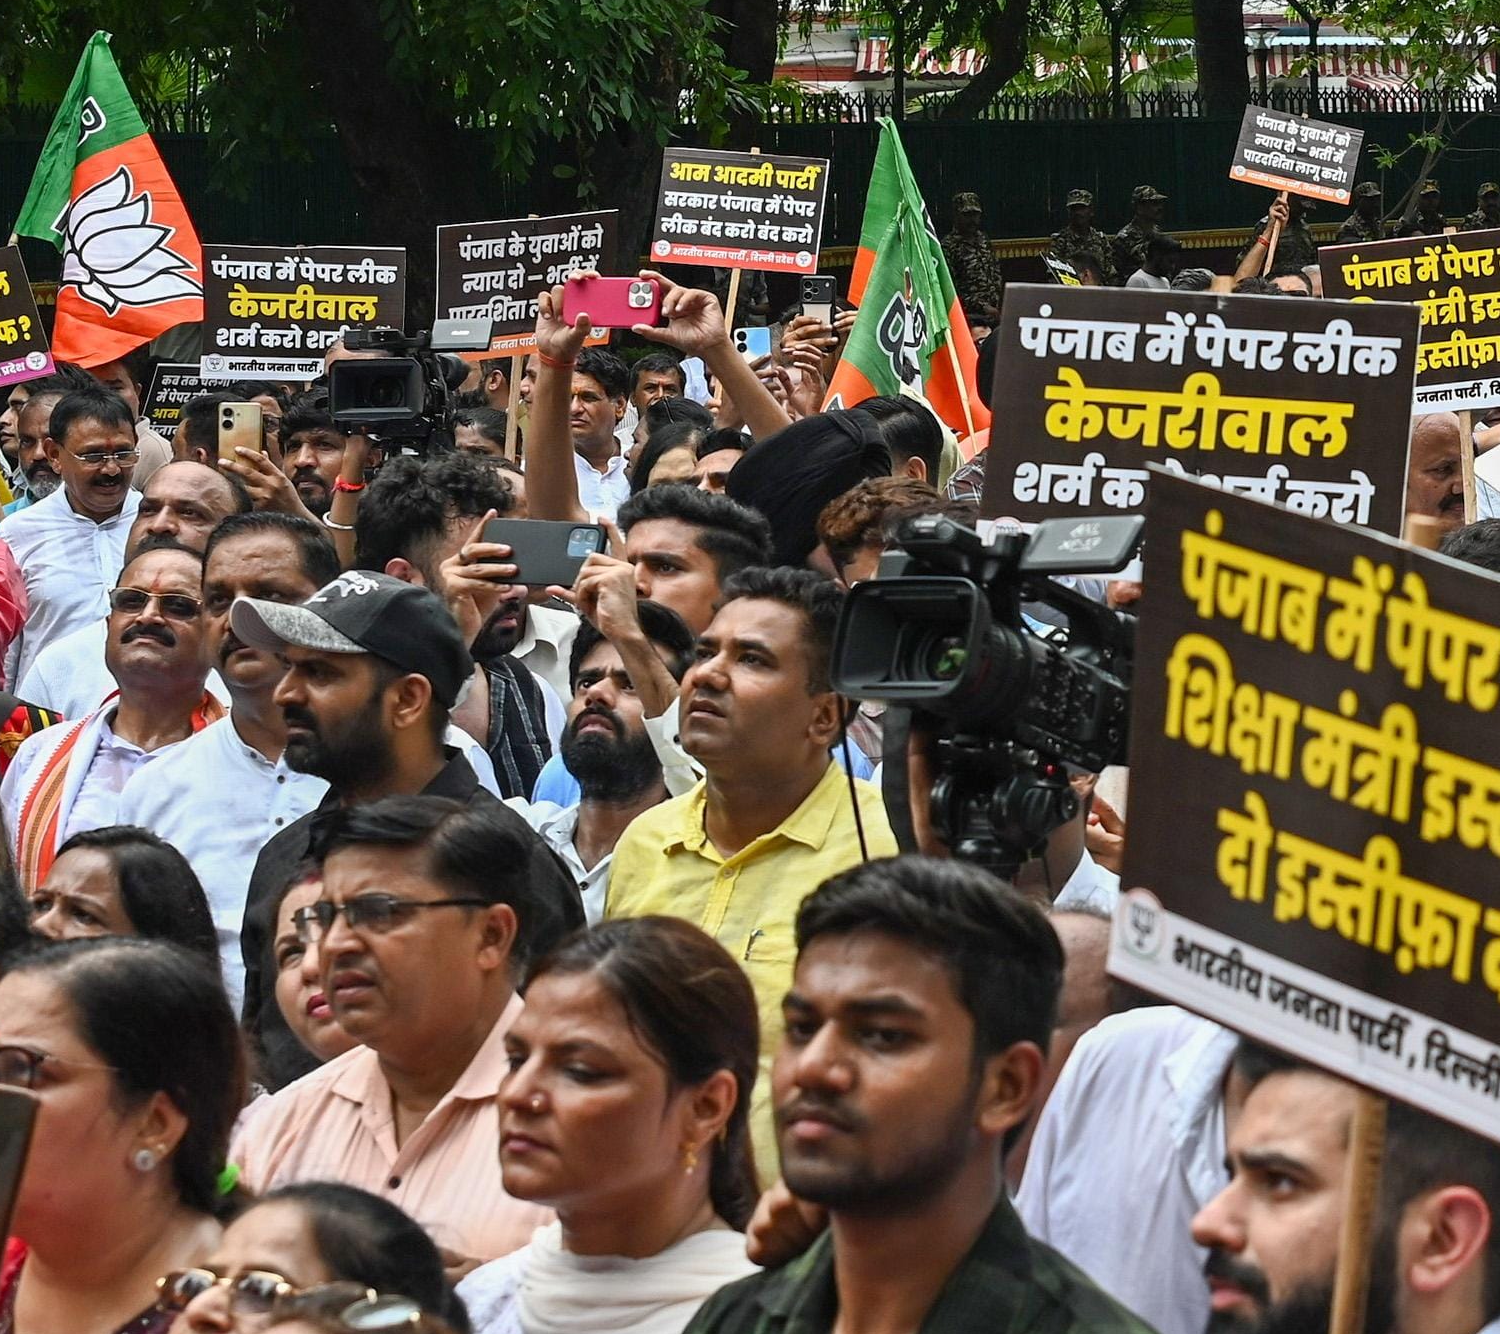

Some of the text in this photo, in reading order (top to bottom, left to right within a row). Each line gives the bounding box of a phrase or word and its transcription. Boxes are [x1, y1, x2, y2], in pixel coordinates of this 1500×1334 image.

[1254, 133, 1348, 163] न्याय दो भर्ती में
[1256, 112, 1352, 147] पंजाब के युवाओं को
[669, 160, 822, 190] आम आदमी पार्टी
[1295, 160, 1321, 182] लागू
[664, 190, 817, 217] सरकार पंजाब में पेपर
[459, 222, 604, 264] पंजाब के युवाओं को
[660, 212, 814, 244] लीक बंद करो बंद करो
[211, 254, 398, 285] पंजाब में पेपर लीक
[462, 262, 525, 294] न्याय दो
[1342, 254, 1412, 291] पंजाब
[1413, 246, 1441, 283] में
[1441, 244, 1495, 280] पेपर
[228, 283, 378, 322] केजरीवाल
[1414, 286, 1467, 327] मंत्री
[215, 321, 303, 349] शर्म करो
[1018, 303, 1402, 377] पंजाब में पेपर लीक
[1044, 366, 1355, 459] केजरीवाल
[1012, 451, 1377, 526] शर्म करो
[1179, 508, 1318, 655] पंजाब
[1327, 555, 1394, 673] में
[1164, 632, 1300, 782] शिक्षा
[1302, 688, 1422, 824] मंत्री
[1214, 790, 1274, 904] दो
[1271, 835, 1485, 987] इस्तीफ़ा
[1171, 934, 1267, 1005] भारतीय
[1269, 978, 1346, 1037] जनता
